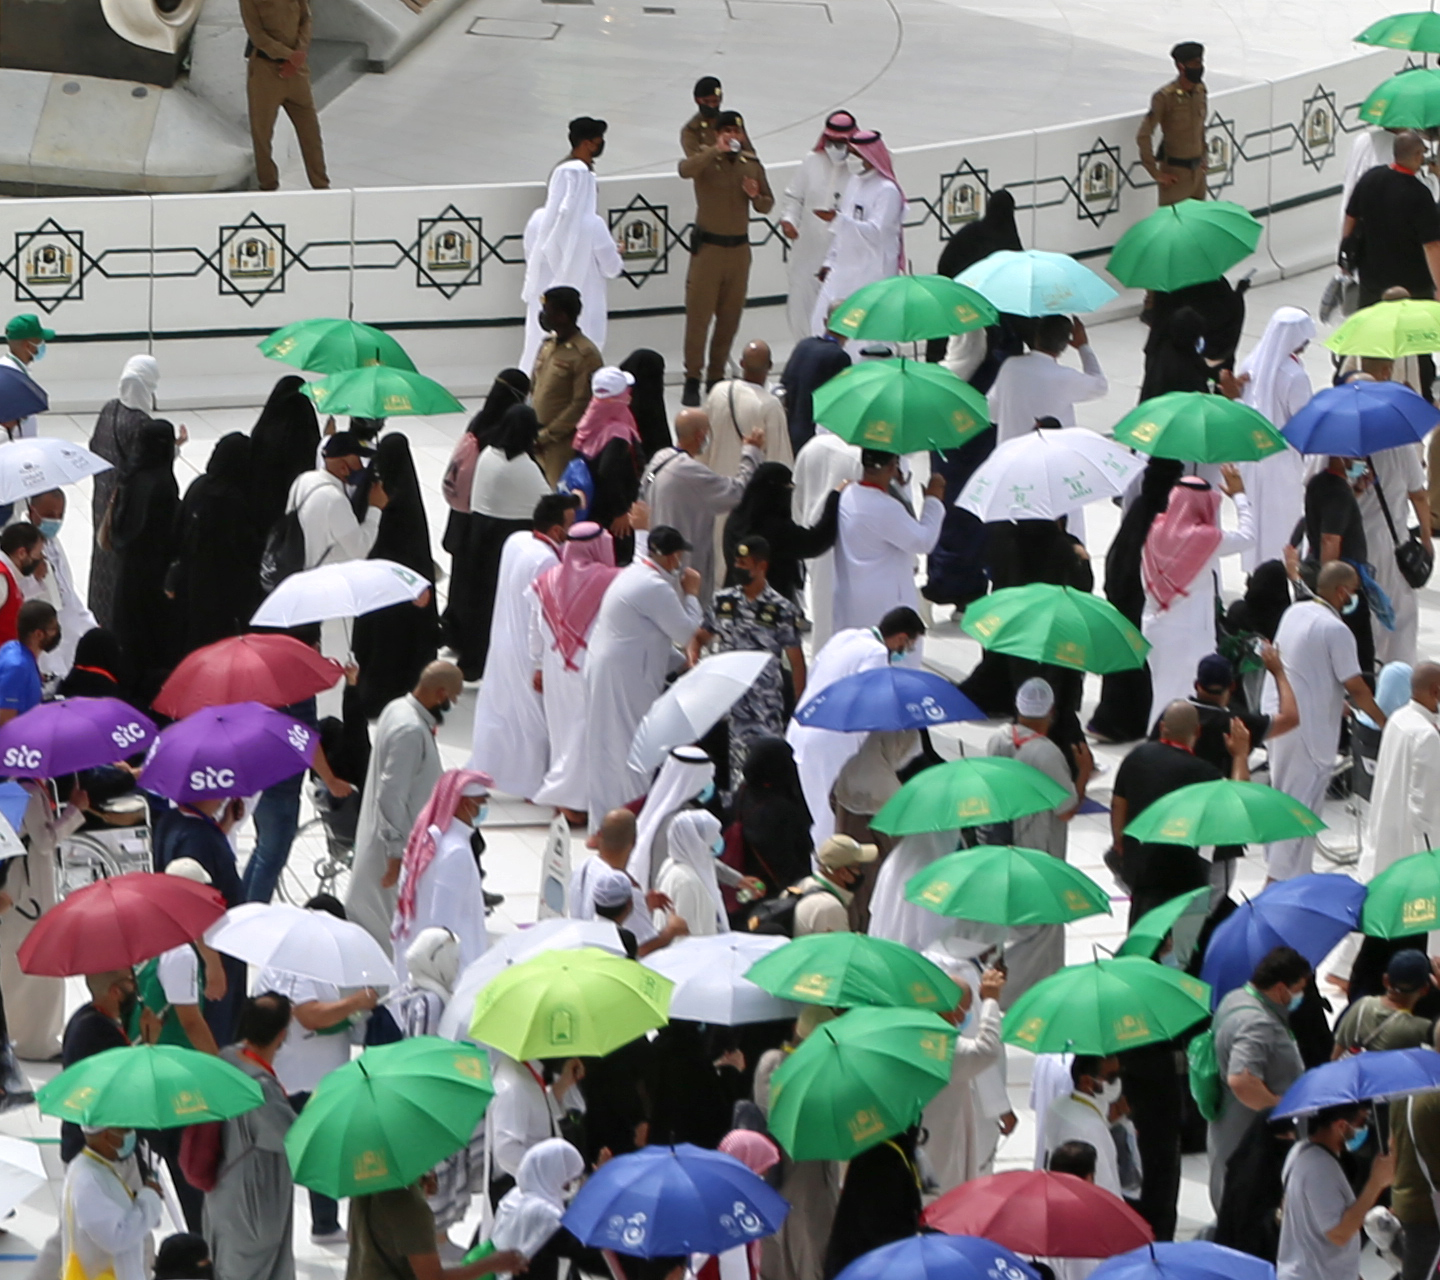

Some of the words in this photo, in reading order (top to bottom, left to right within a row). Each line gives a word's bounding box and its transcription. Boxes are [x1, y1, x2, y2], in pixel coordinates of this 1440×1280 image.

[112, 721, 145, 747] stc
[289, 725, 310, 752] stc
[4, 743, 42, 768] stc
[191, 766, 235, 790] stc
